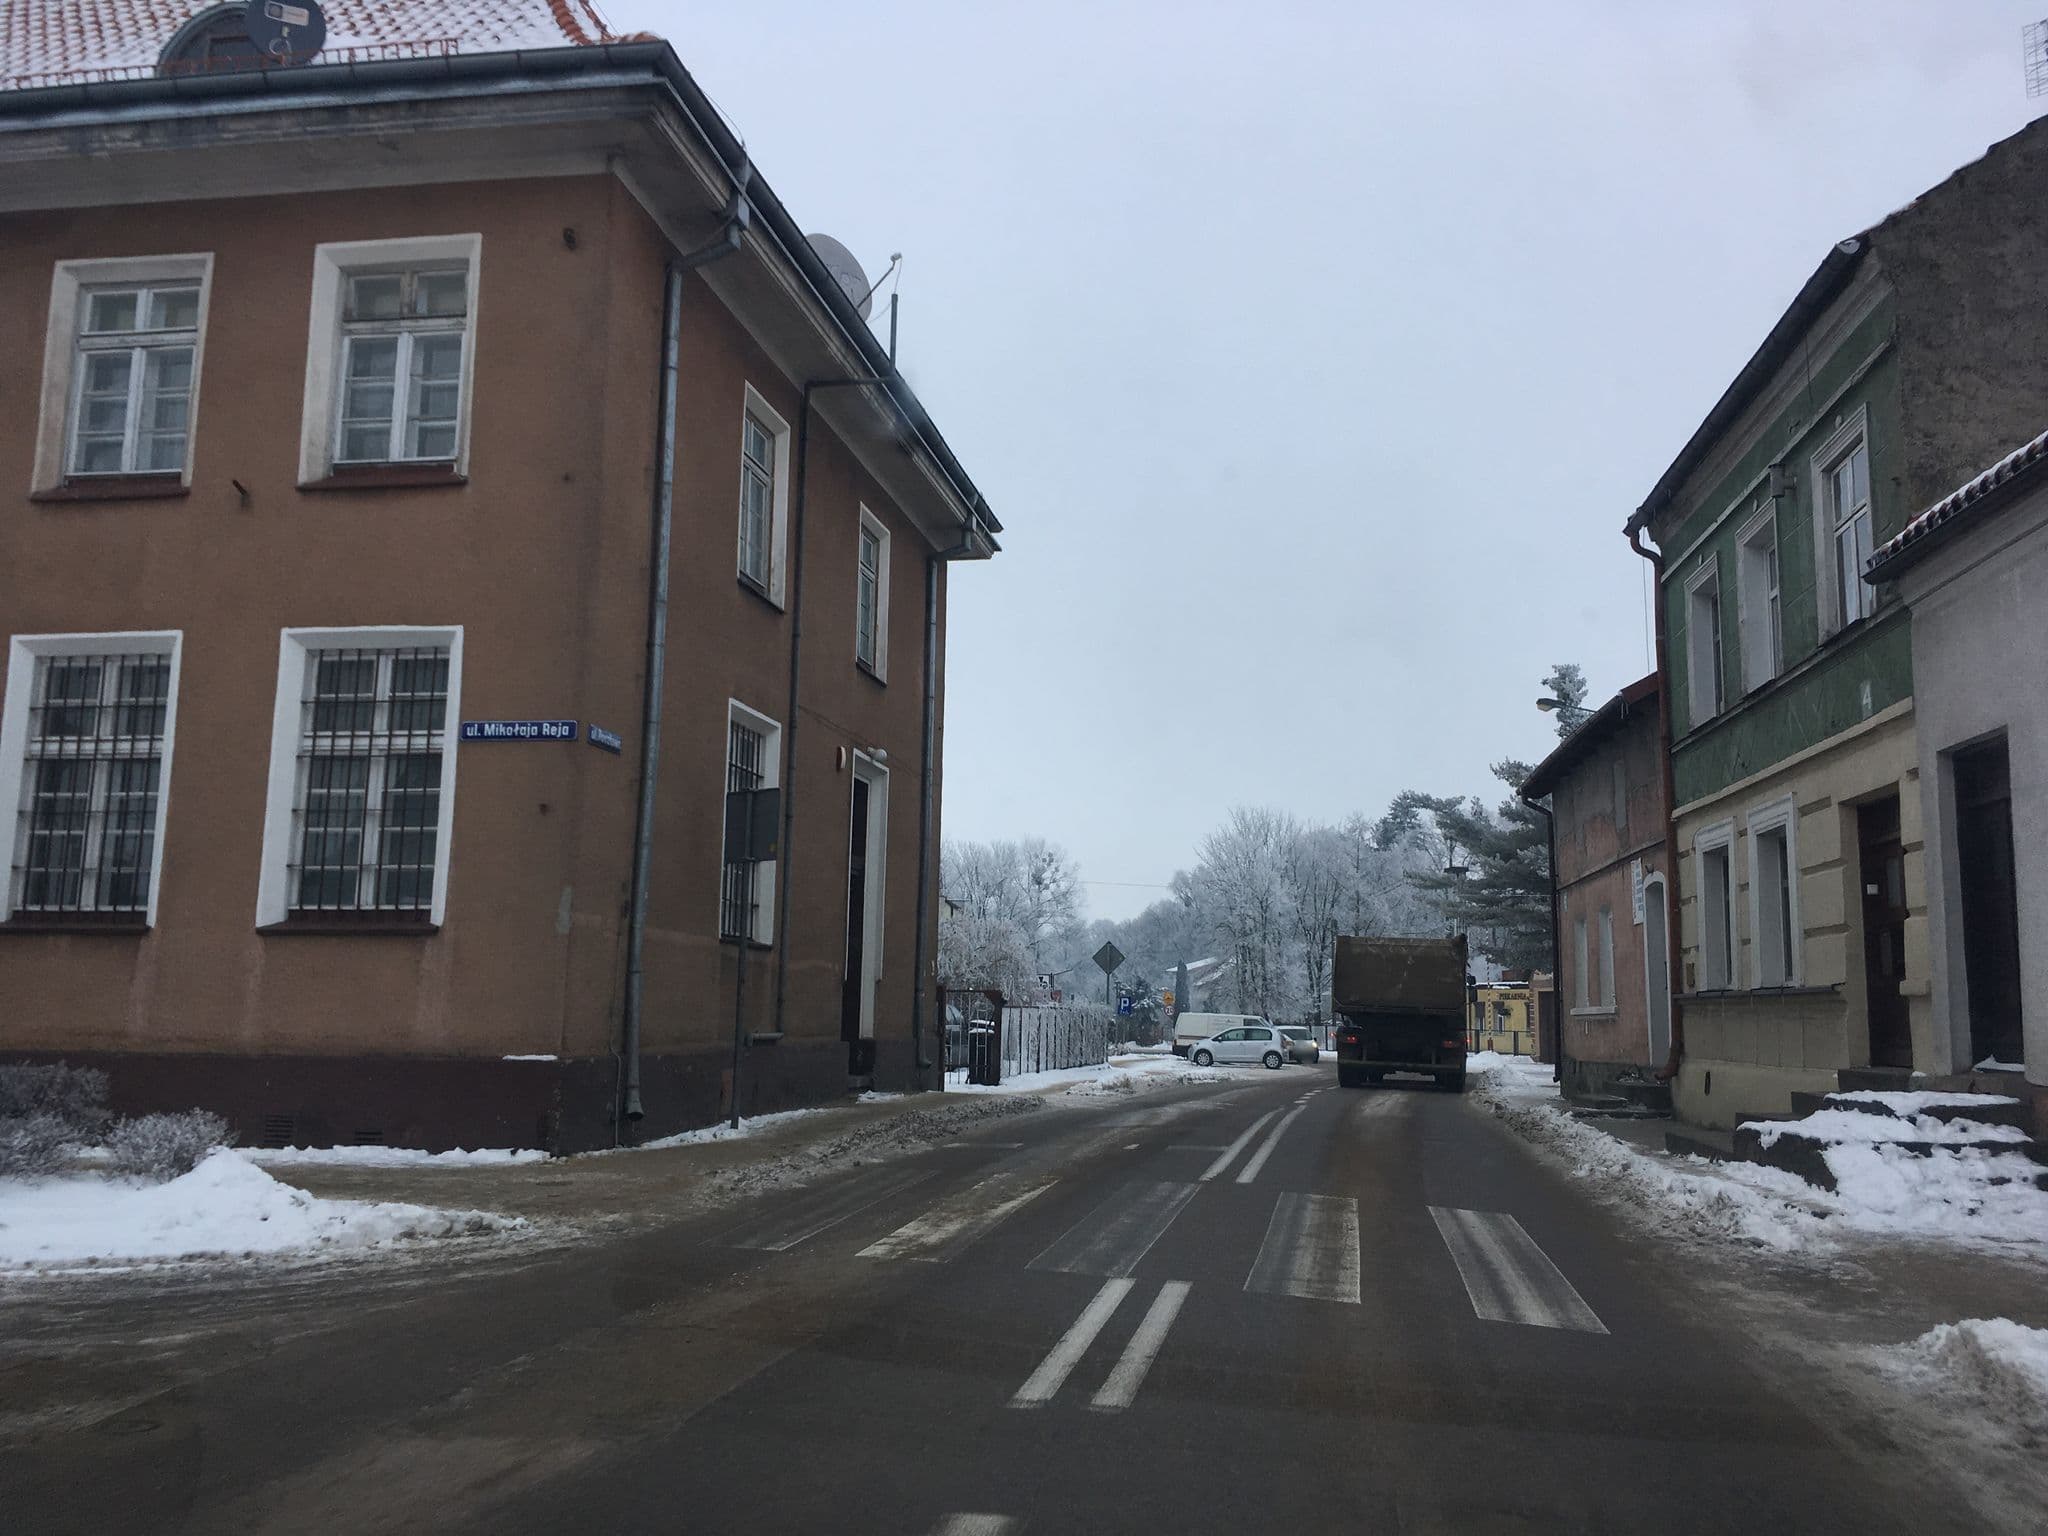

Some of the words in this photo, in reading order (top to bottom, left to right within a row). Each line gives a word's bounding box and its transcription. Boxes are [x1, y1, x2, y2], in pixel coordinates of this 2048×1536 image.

[467, 724, 480, 736] ul.
[484, 723, 538, 738] Mikołaja
[542, 723, 569, 738] Reja
[1121, 998, 1129, 1010] P
